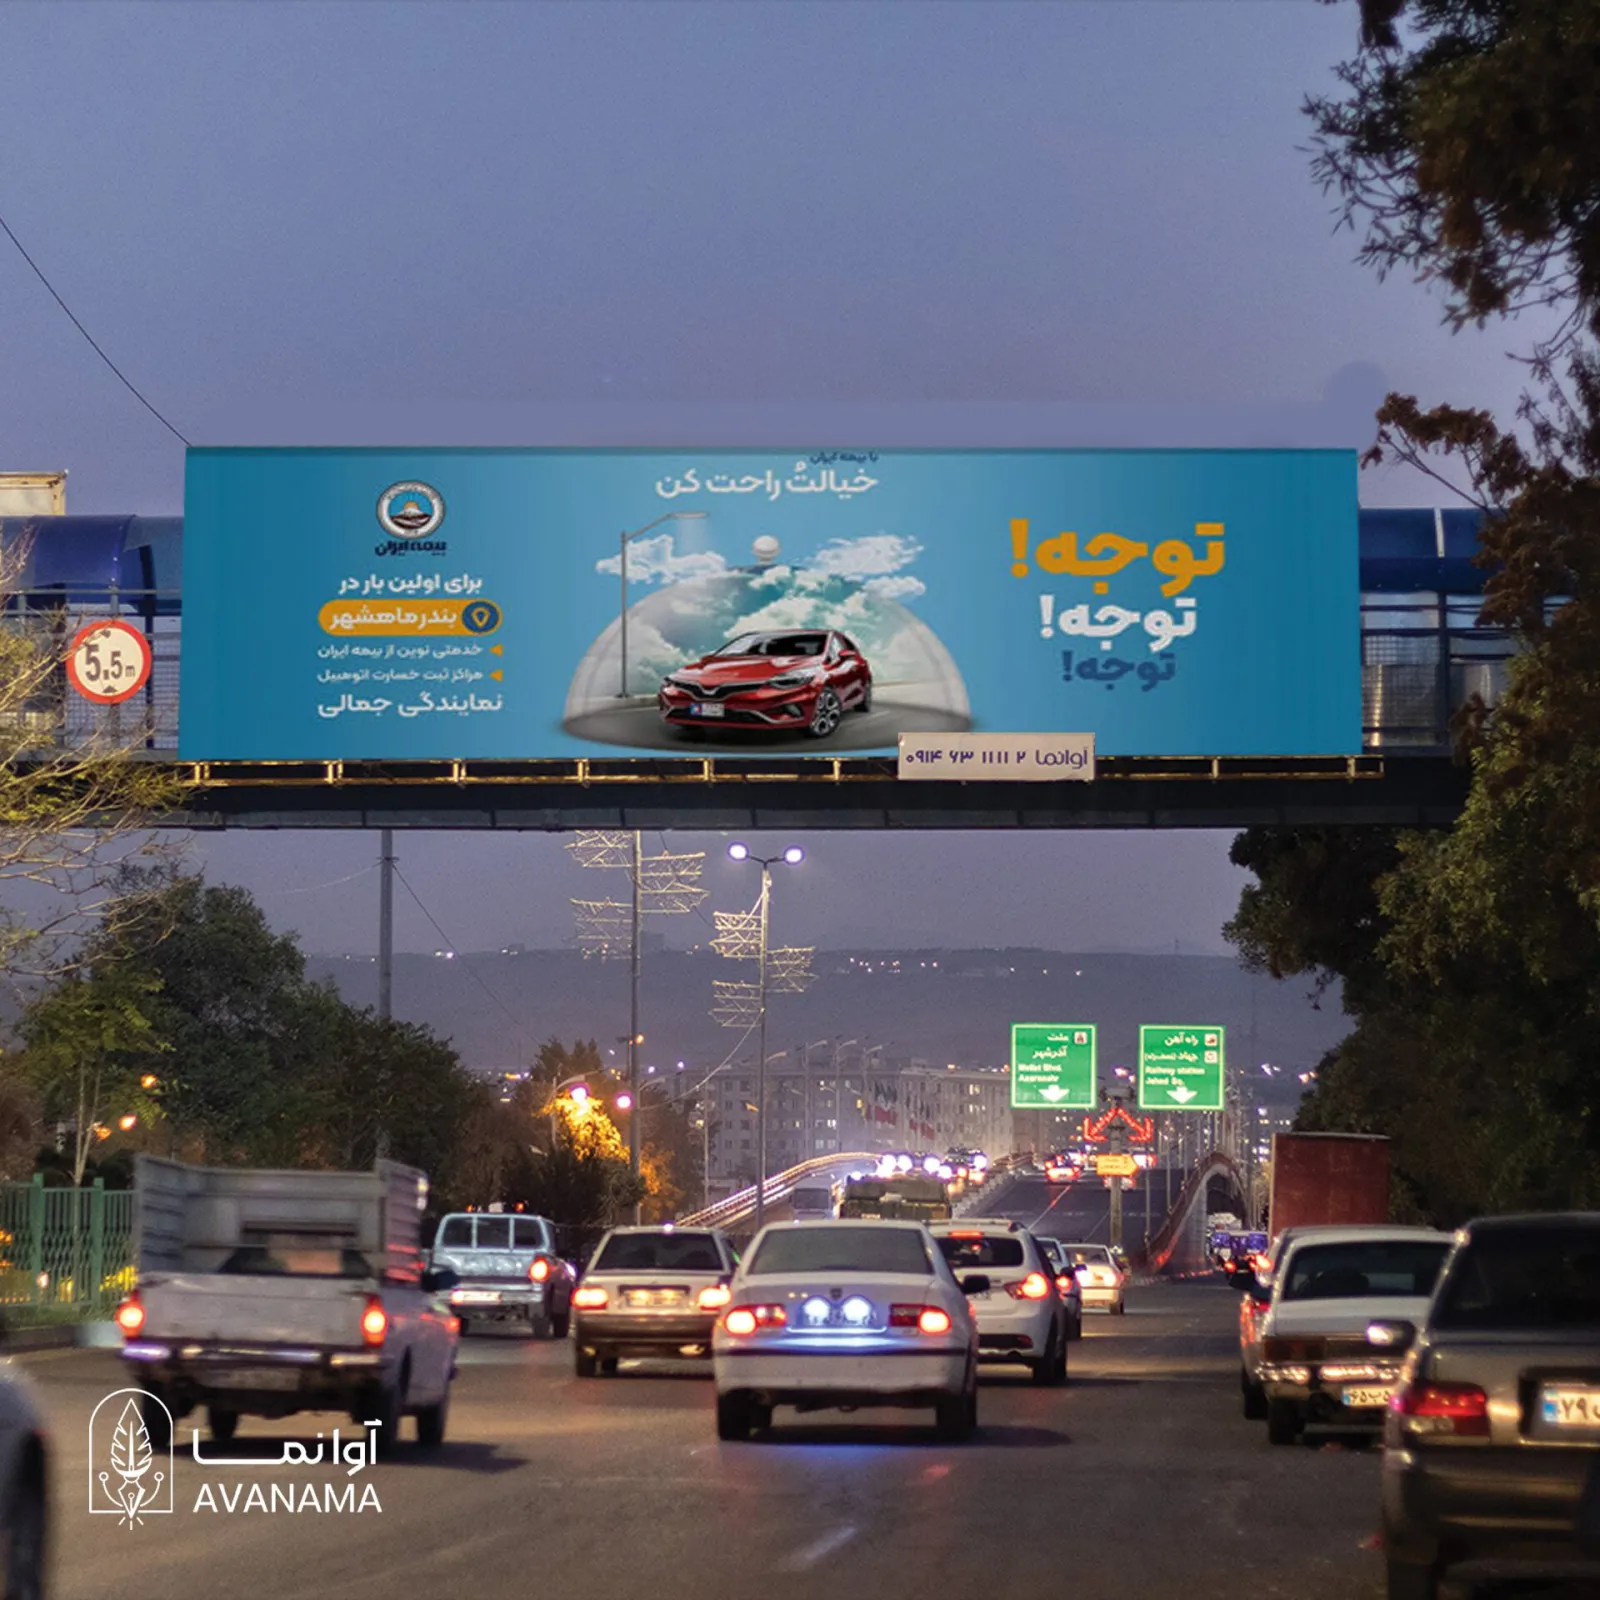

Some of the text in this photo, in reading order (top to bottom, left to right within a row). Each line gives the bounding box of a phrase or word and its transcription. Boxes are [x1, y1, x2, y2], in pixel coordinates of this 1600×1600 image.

[655, 467, 700, 498] کن
[705, 469, 781, 501] راحت
[1010, 518, 1225, 597] توجه!
[338, 574, 483, 595] برای اولین بار در
[1039, 594, 1197, 652] توجه!
[317, 644, 483, 660] خدمتی نوین از بیمه ایران
[372, 668, 420, 684] خسارت
[422, 668, 449, 682] ثبت
[451, 668, 484, 684] مراکز
[1061, 650, 1176, 692] توجه!
[317, 691, 502, 718] نمایندگی جمالی
[905, 749, 943, 764] ۰۹۱۴
[949, 750, 974, 764] ۶۳
[1035, 746, 1089, 769] آوانما
